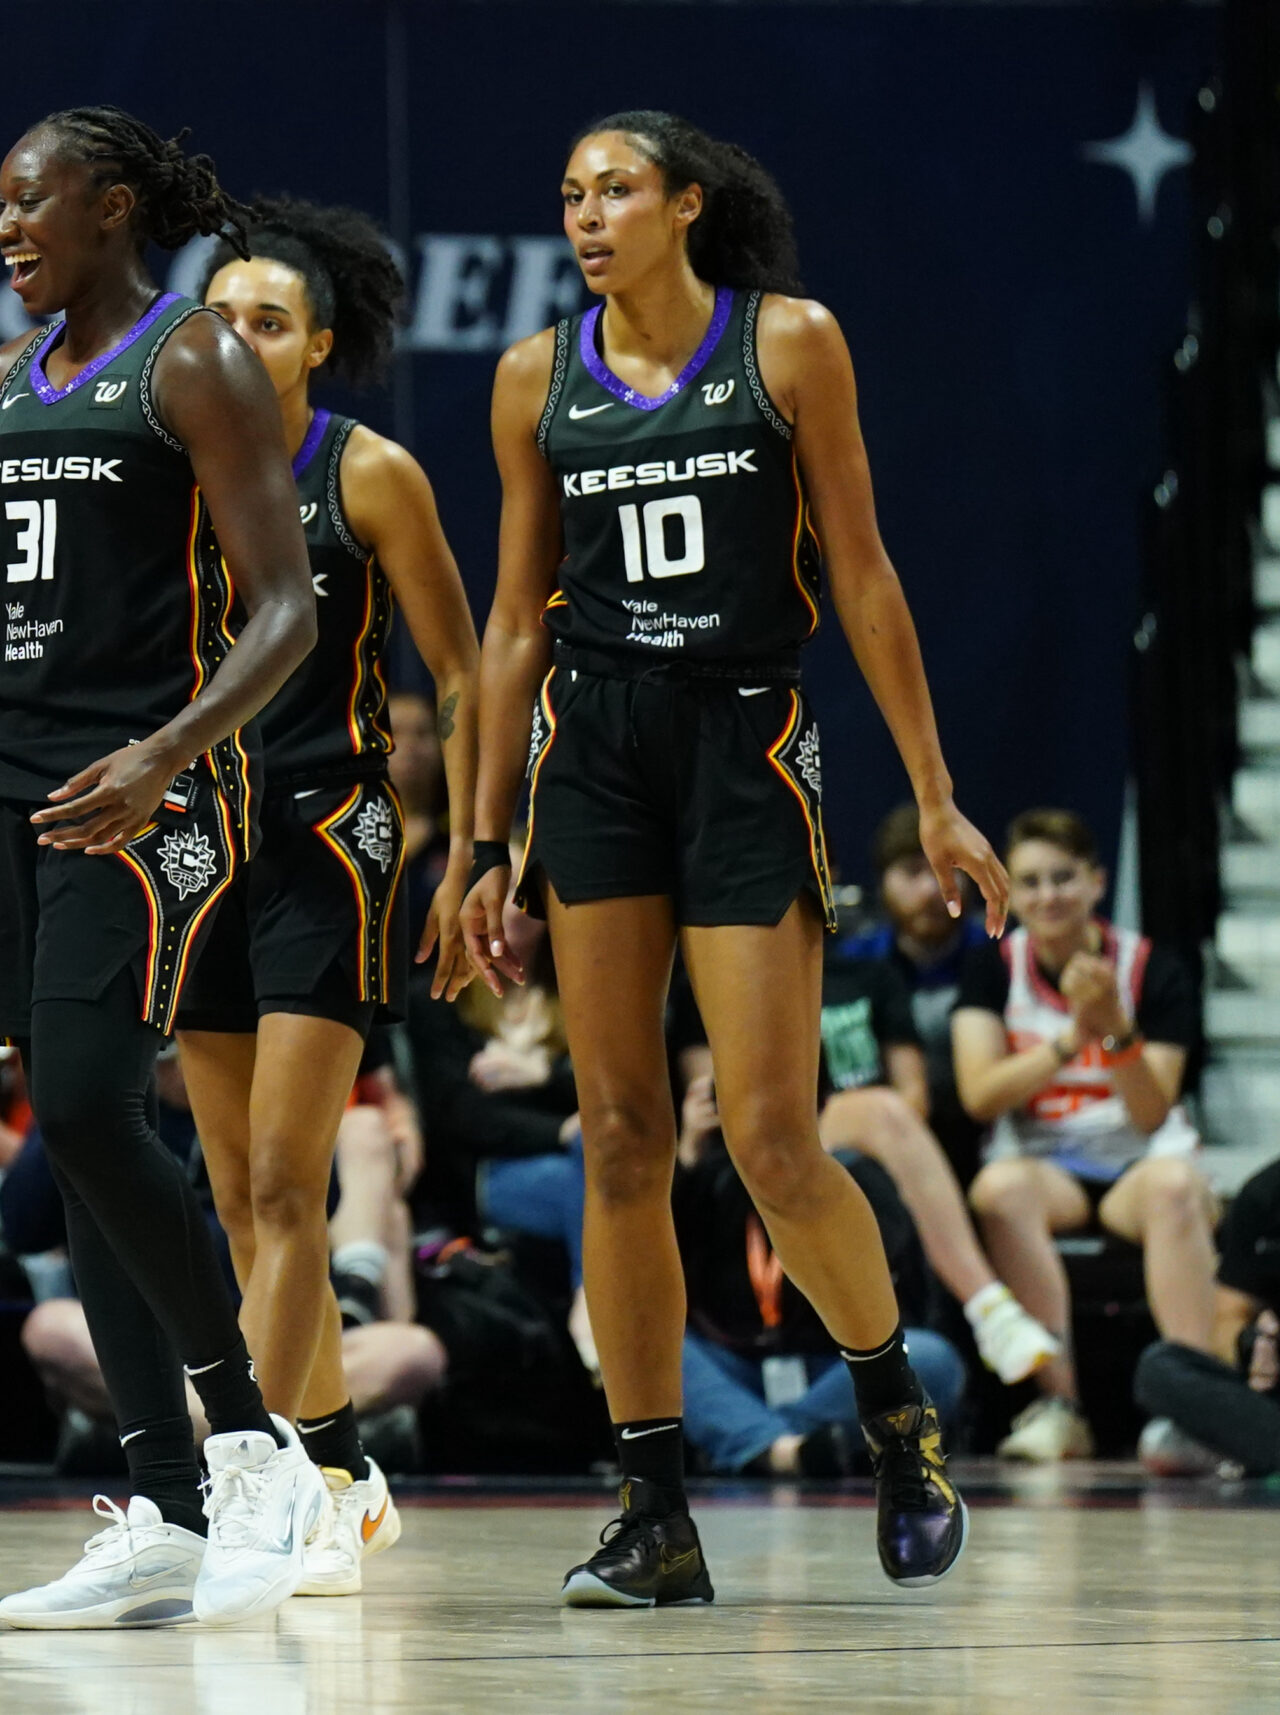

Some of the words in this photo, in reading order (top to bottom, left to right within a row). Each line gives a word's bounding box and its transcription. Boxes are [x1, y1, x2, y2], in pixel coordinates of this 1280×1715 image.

[563, 448, 759, 498] KEESUSK
[4, 498, 57, 583] 31
[617, 494, 705, 583] 10
[5, 601, 25, 620] Yale
[621, 599, 658, 614] Yale
[6, 619, 64, 641] NewHaven
[631, 612, 720, 631] NewHaven
[625, 629, 685, 648] Health
[4, 640, 44, 662] Health
